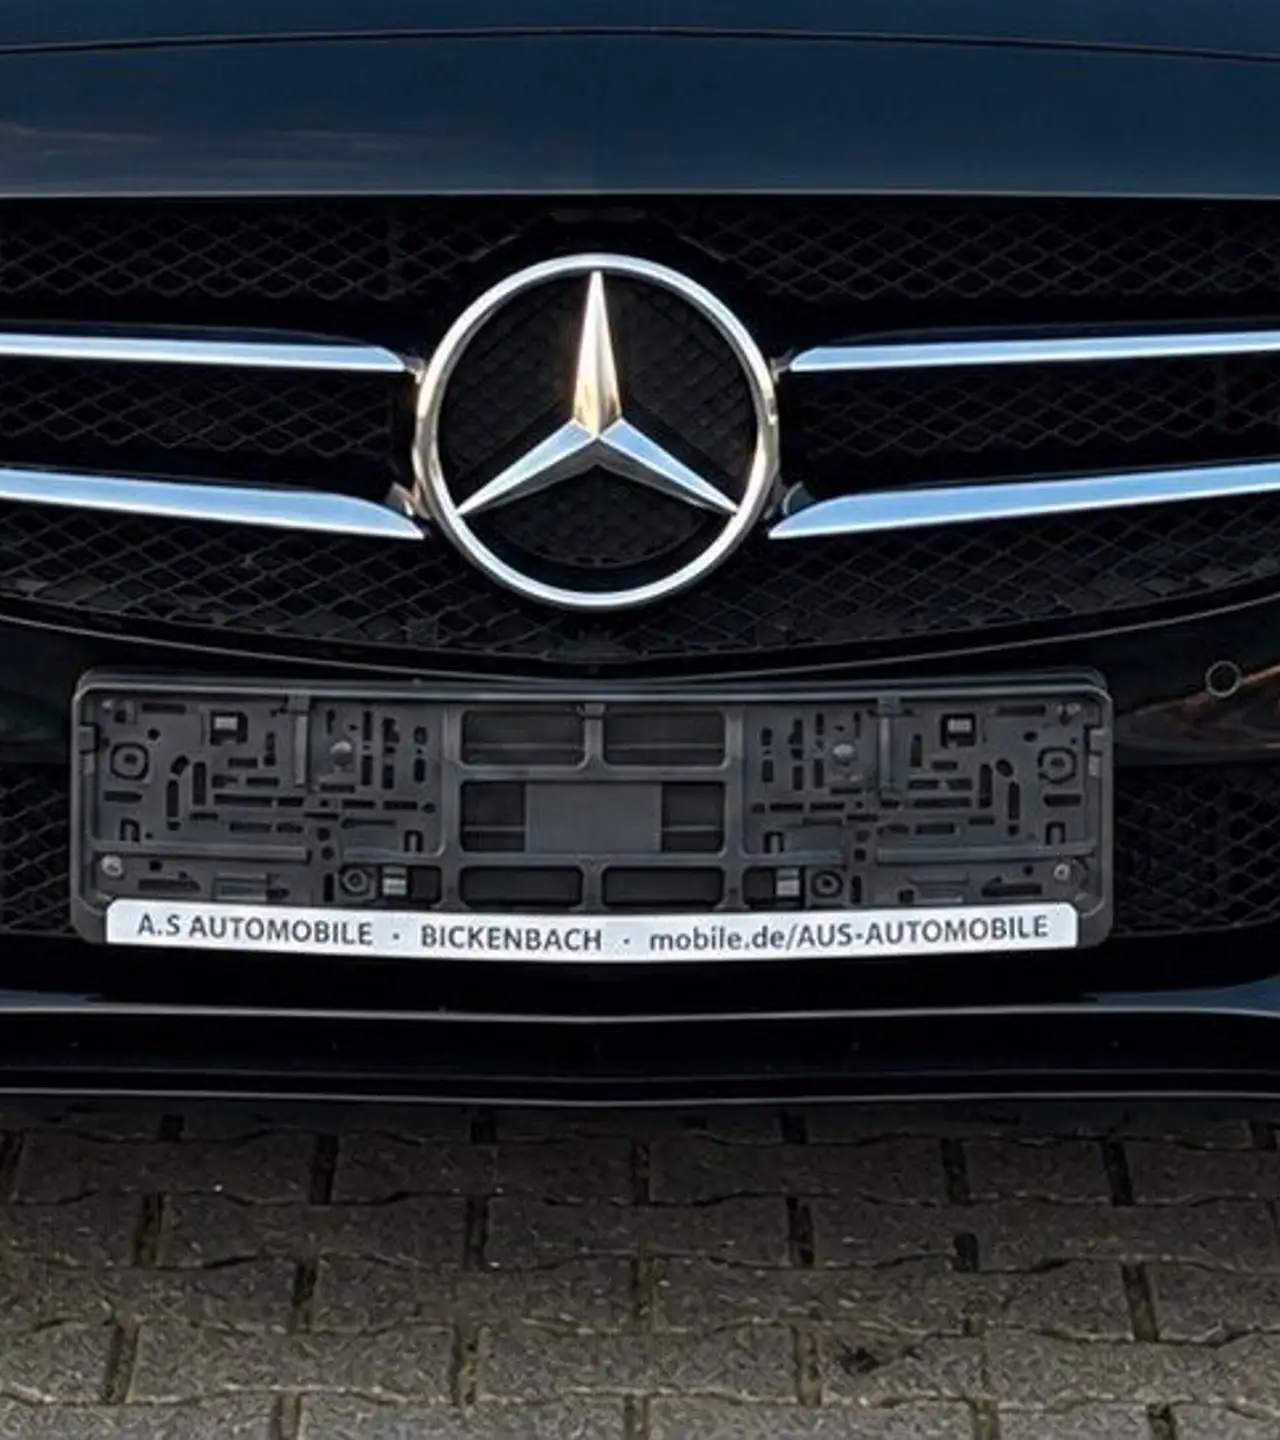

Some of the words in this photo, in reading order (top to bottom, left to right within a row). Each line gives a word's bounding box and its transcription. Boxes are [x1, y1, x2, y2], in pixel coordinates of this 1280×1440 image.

[138, 913, 180, 936] A.S
[189, 916, 373, 946] AUTOMOBILE
[421, 925, 602, 951] BICKENBACH
[650, 915, 1048, 952] mobile.de/AUS-AUTOMOBILE
